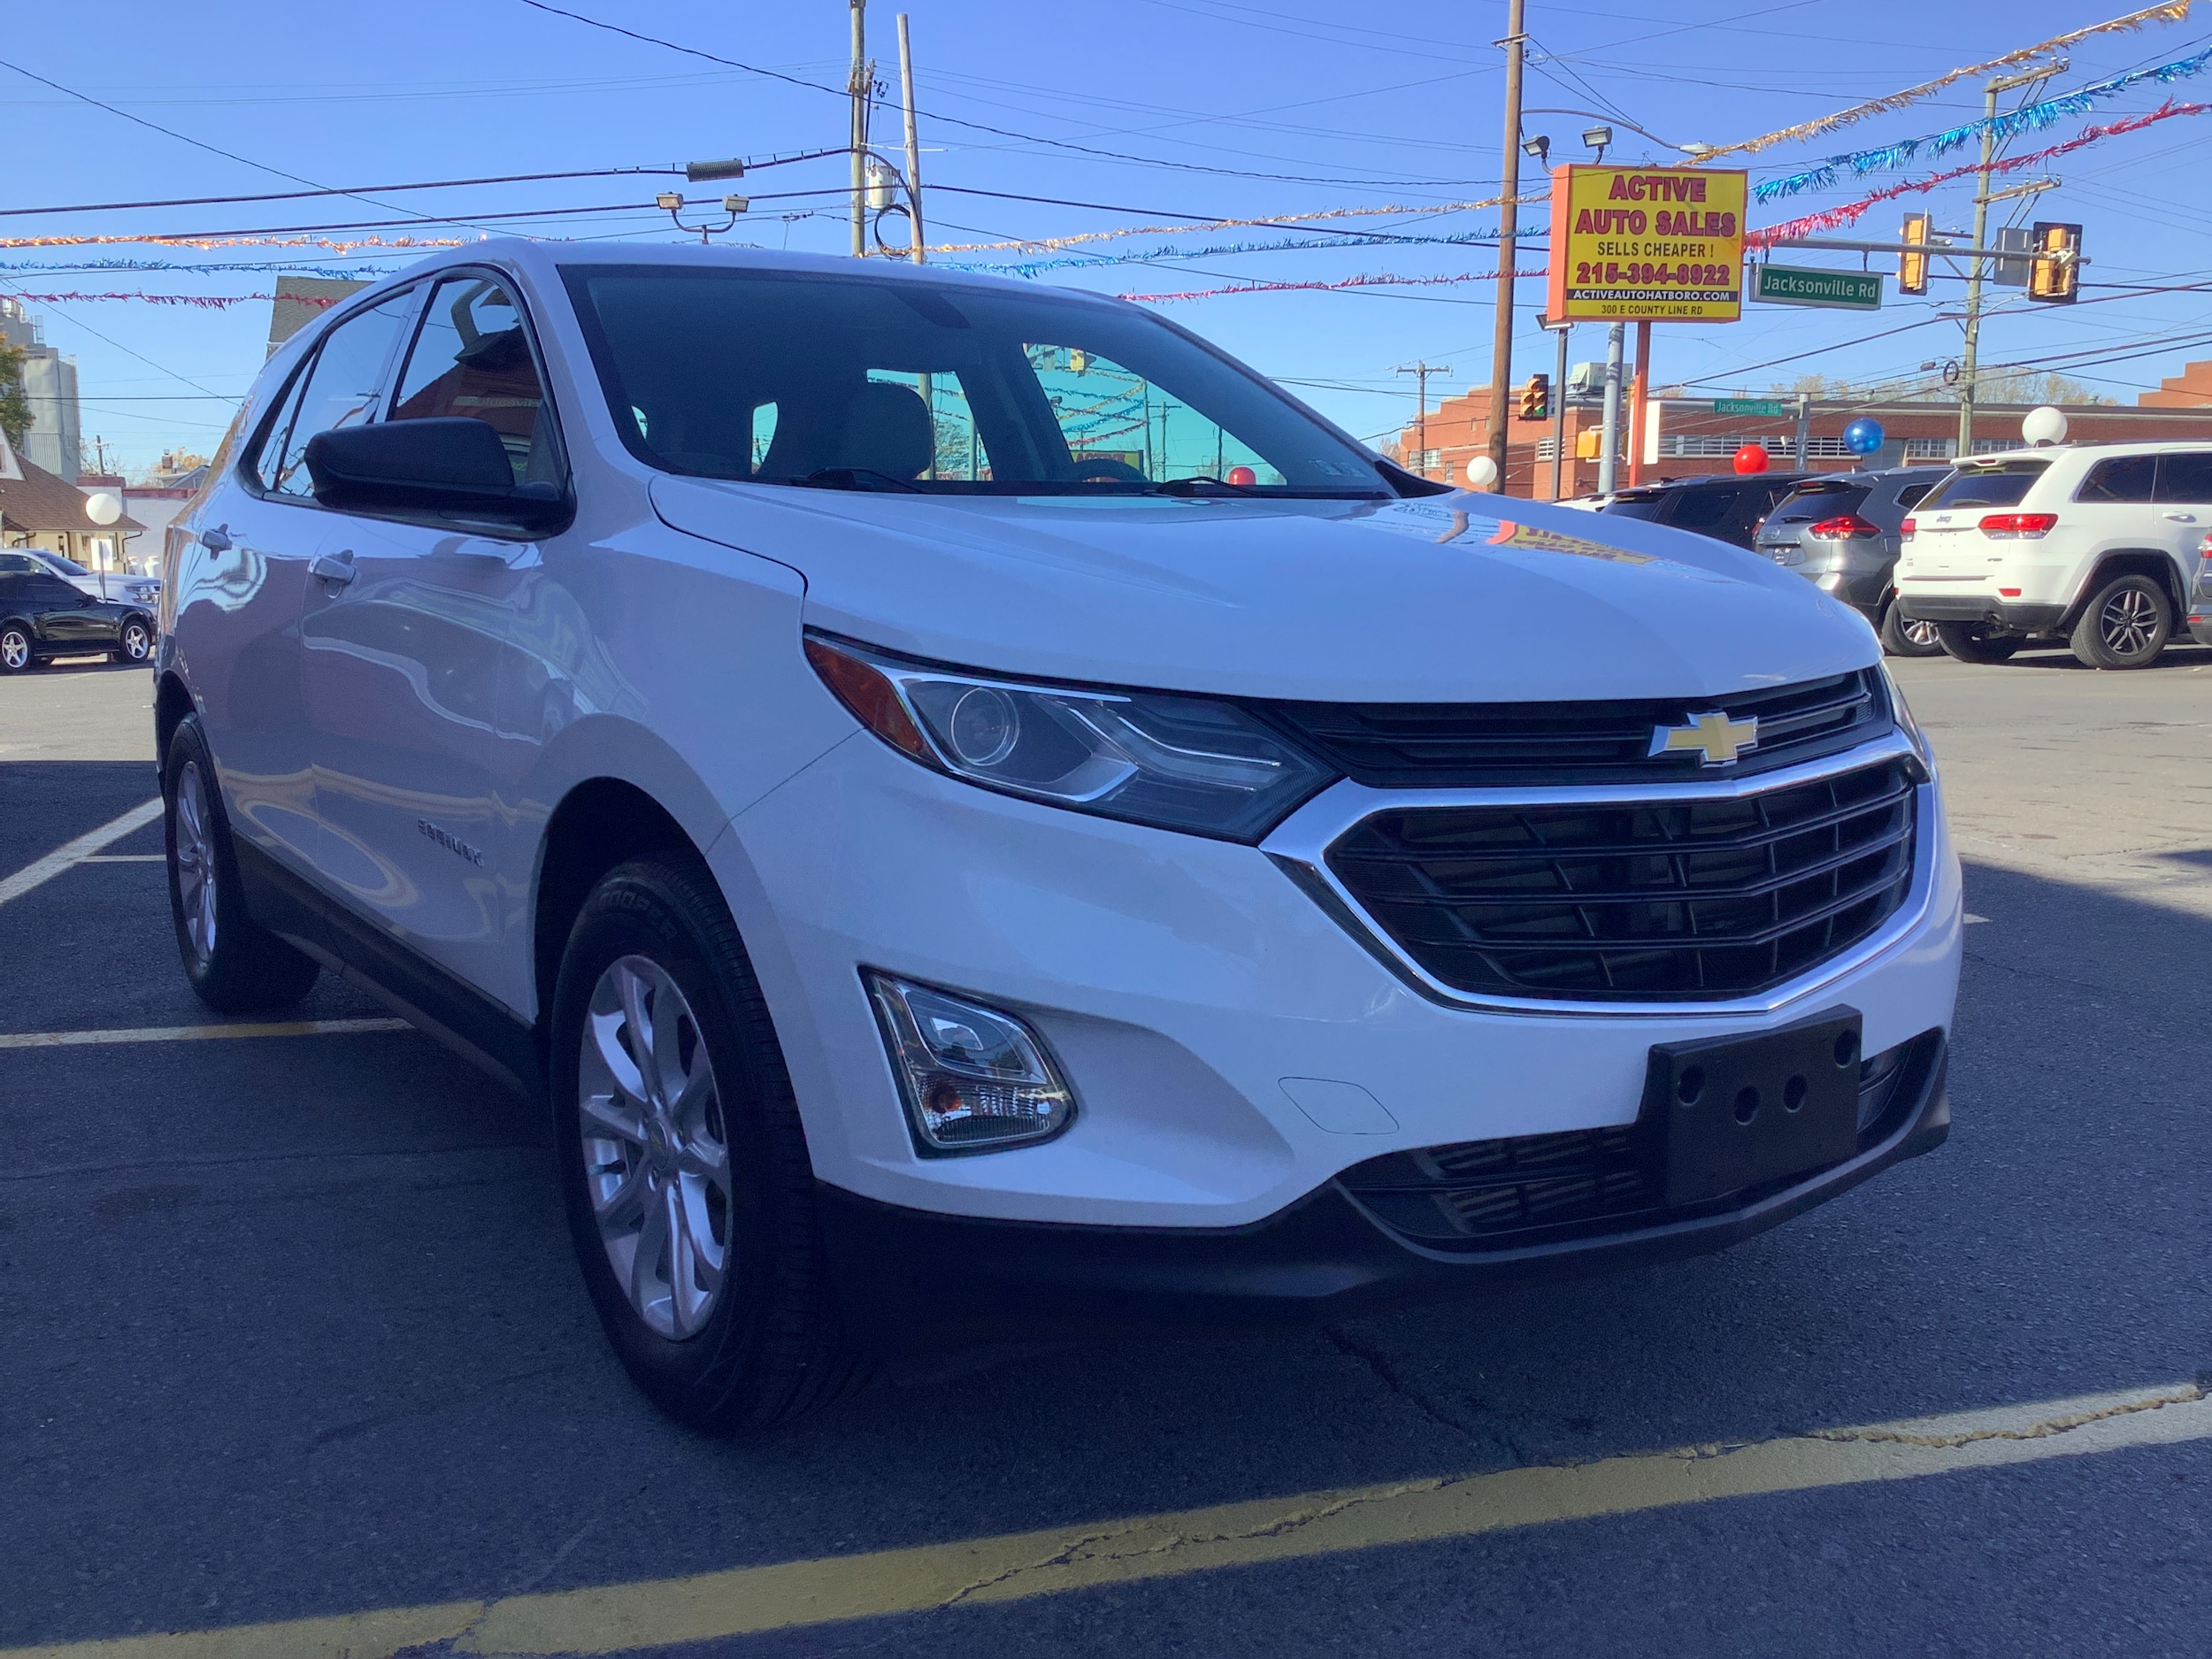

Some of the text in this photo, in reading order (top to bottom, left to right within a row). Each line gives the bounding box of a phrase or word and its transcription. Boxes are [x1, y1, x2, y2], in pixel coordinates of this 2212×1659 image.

[1608, 174, 1707, 203] ACTIVE
[1574, 208, 1736, 238] AUTO SALES
[1597, 242, 1640, 257] SELLS
[1644, 242, 1706, 258] CHEAPER
[1576, 262, 1731, 287] 215-394-8922
[1572, 289, 1731, 302] ACTIVEAUTOHATBORO.COM
[1763, 275, 1877, 299] Jacksonville Rd
[1601, 304, 1703, 316] 300 E COUNTY LINE RD
[1717, 401, 1778, 415] Jacksonville Rd
